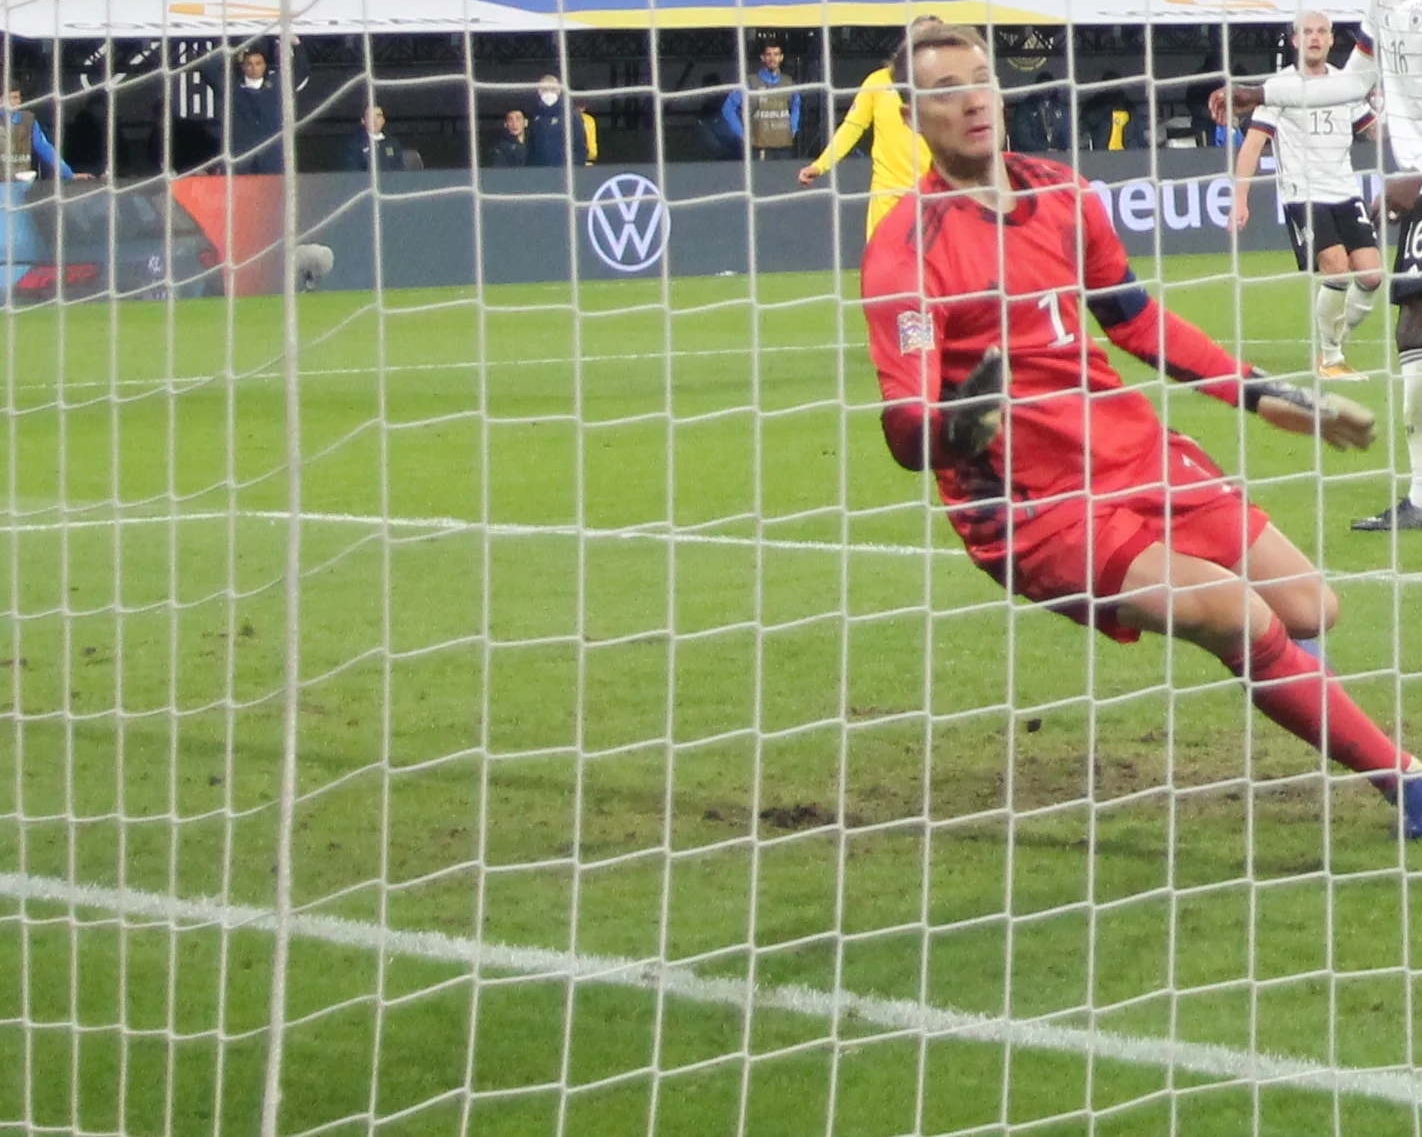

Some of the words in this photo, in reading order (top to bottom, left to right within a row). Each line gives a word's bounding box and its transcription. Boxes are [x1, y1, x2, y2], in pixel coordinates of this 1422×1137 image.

[1391, 40, 1408, 74] 16
[1309, 110, 1334, 136] 13
[1038, 290, 1074, 347] 1
